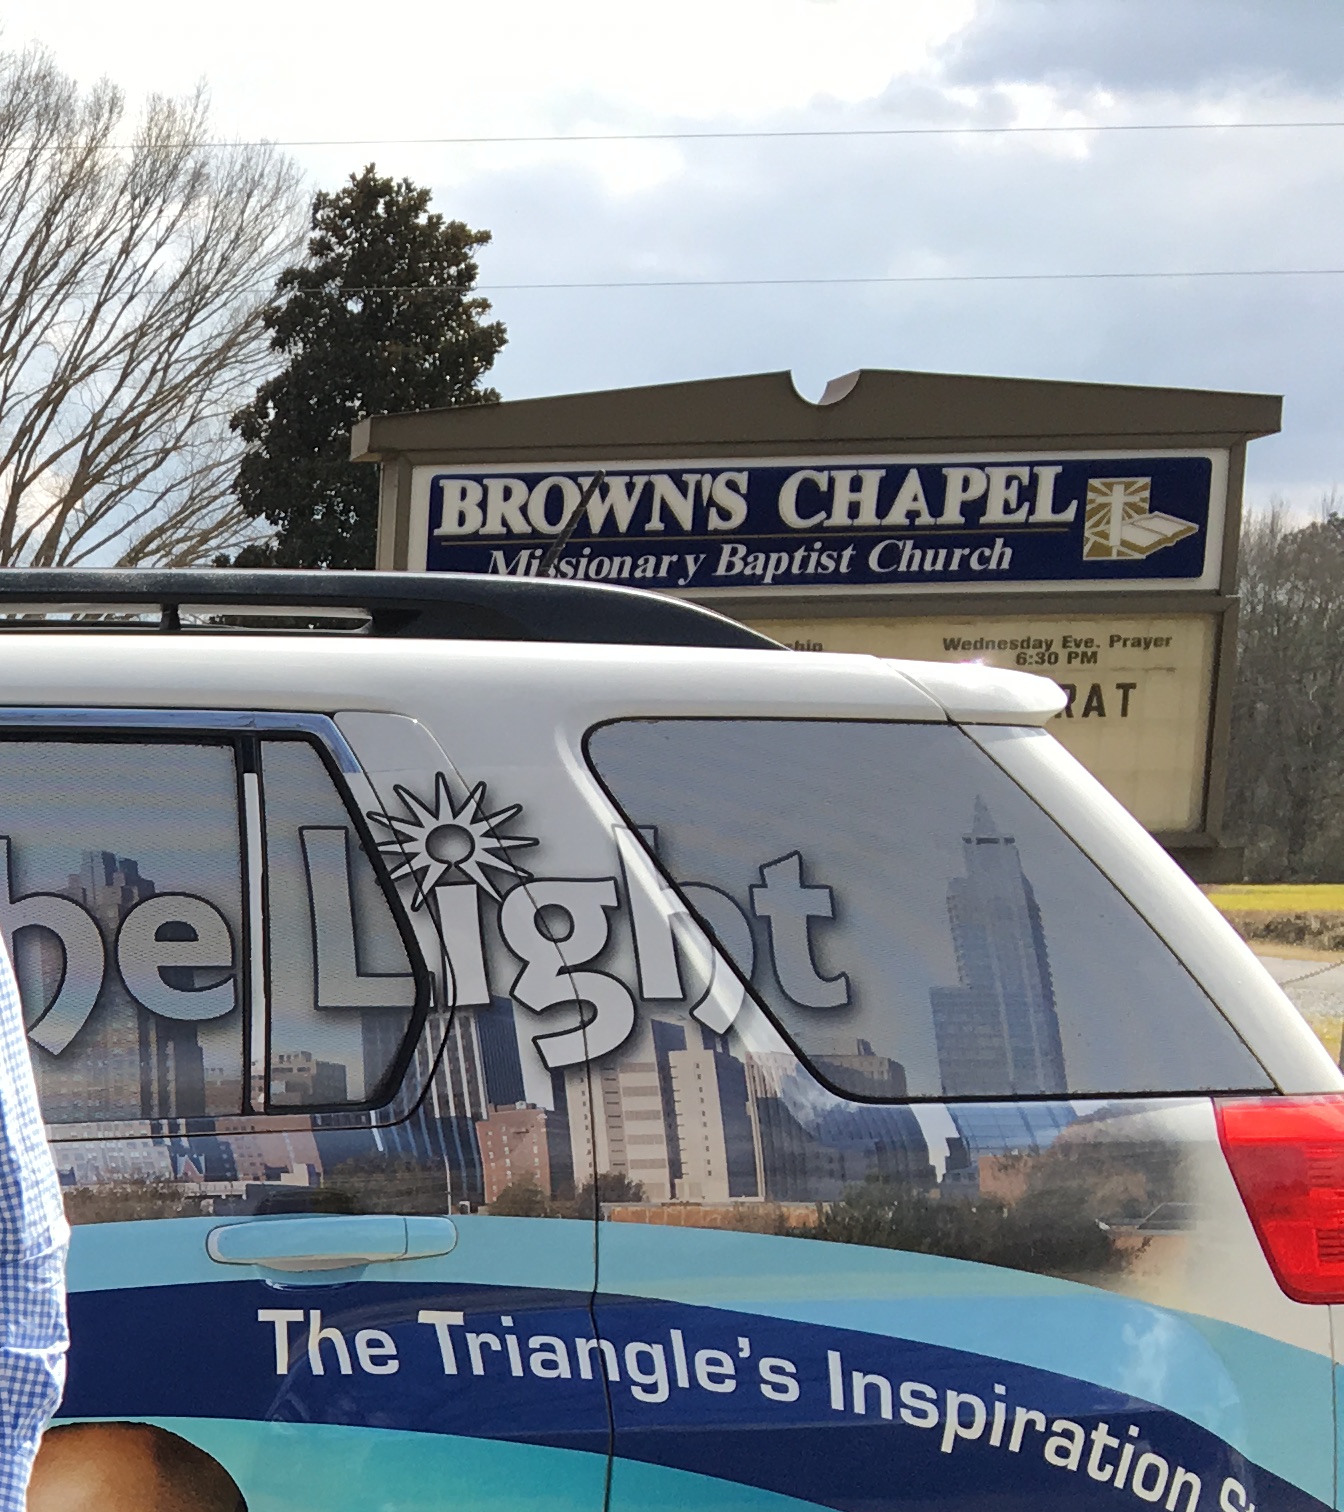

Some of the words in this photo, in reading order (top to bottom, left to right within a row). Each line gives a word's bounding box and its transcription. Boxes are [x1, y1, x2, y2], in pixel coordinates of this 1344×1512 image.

[433, 470, 749, 536] BROWN'S
[778, 464, 1078, 529] CHAPEL
[713, 541, 856, 584] Baptist
[868, 537, 1013, 573] Church
[942, 635, 1054, 652] Wednesday
[1061, 635, 1101, 650] Eve.
[1108, 633, 1173, 650] Prayer
[1015, 651, 1059, 666] 6:30
[1067, 651, 1099, 666] PM
[298, 773, 851, 1070] Light
[257, 1309, 400, 1376] The
[417, 1309, 800, 1404] Triangle's
